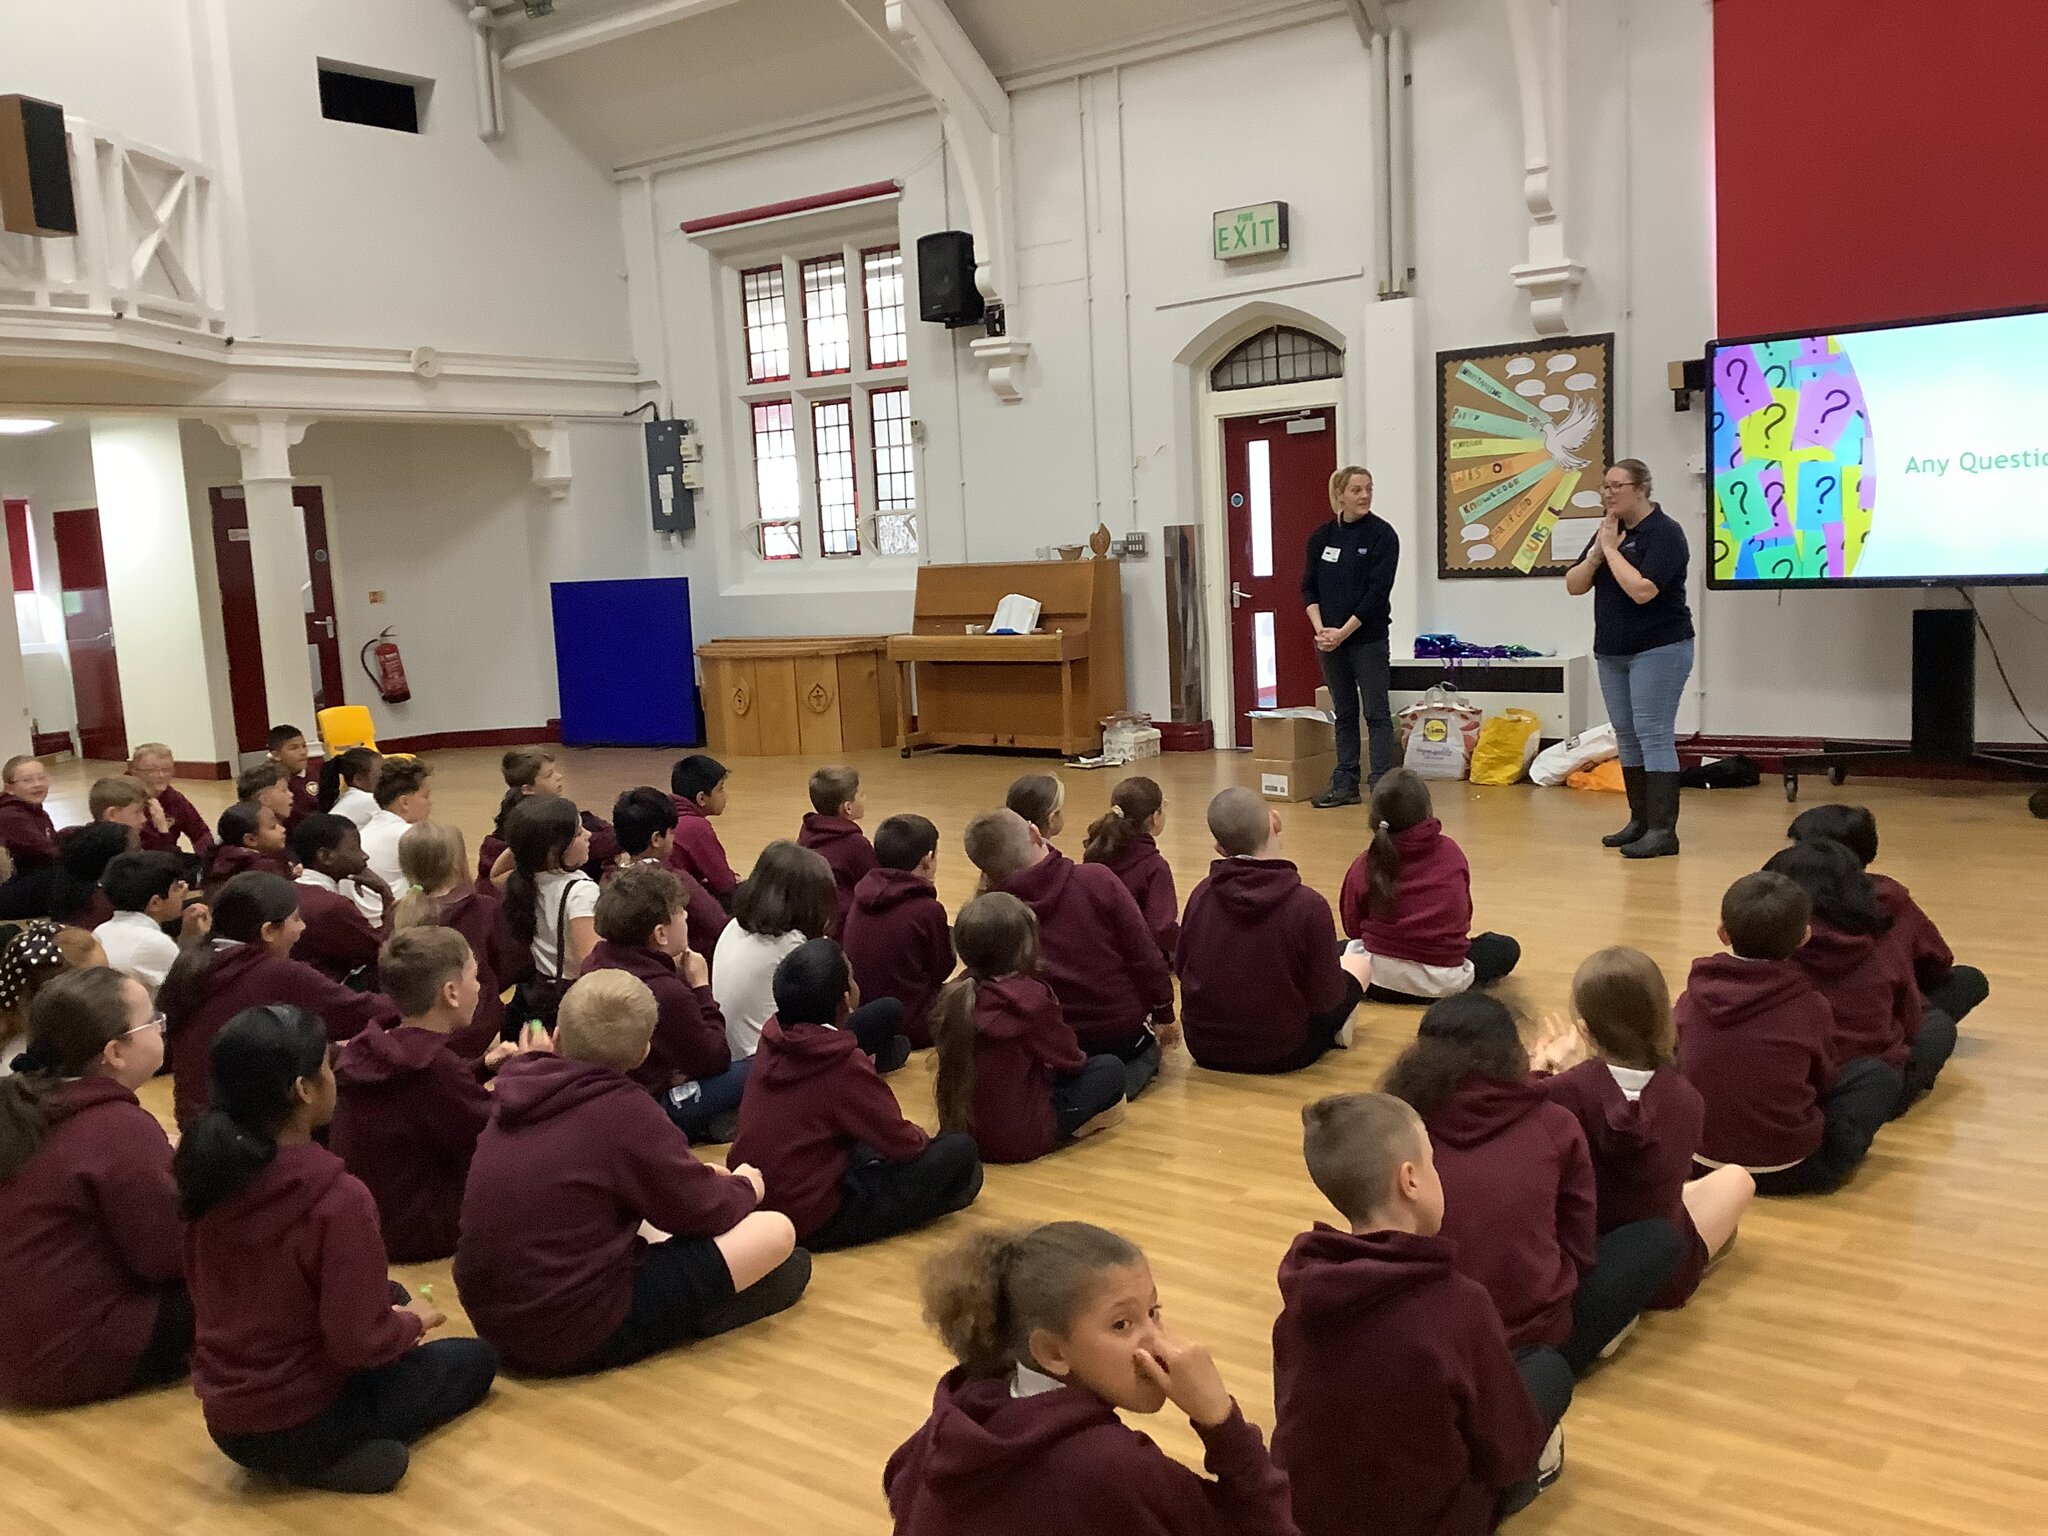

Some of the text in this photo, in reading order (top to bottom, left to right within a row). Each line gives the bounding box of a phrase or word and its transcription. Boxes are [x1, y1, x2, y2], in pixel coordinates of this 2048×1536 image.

[1218, 219, 1275, 252] EXIT
[1452, 460, 1514, 483] WISO
[1905, 455, 1950, 477] Any
